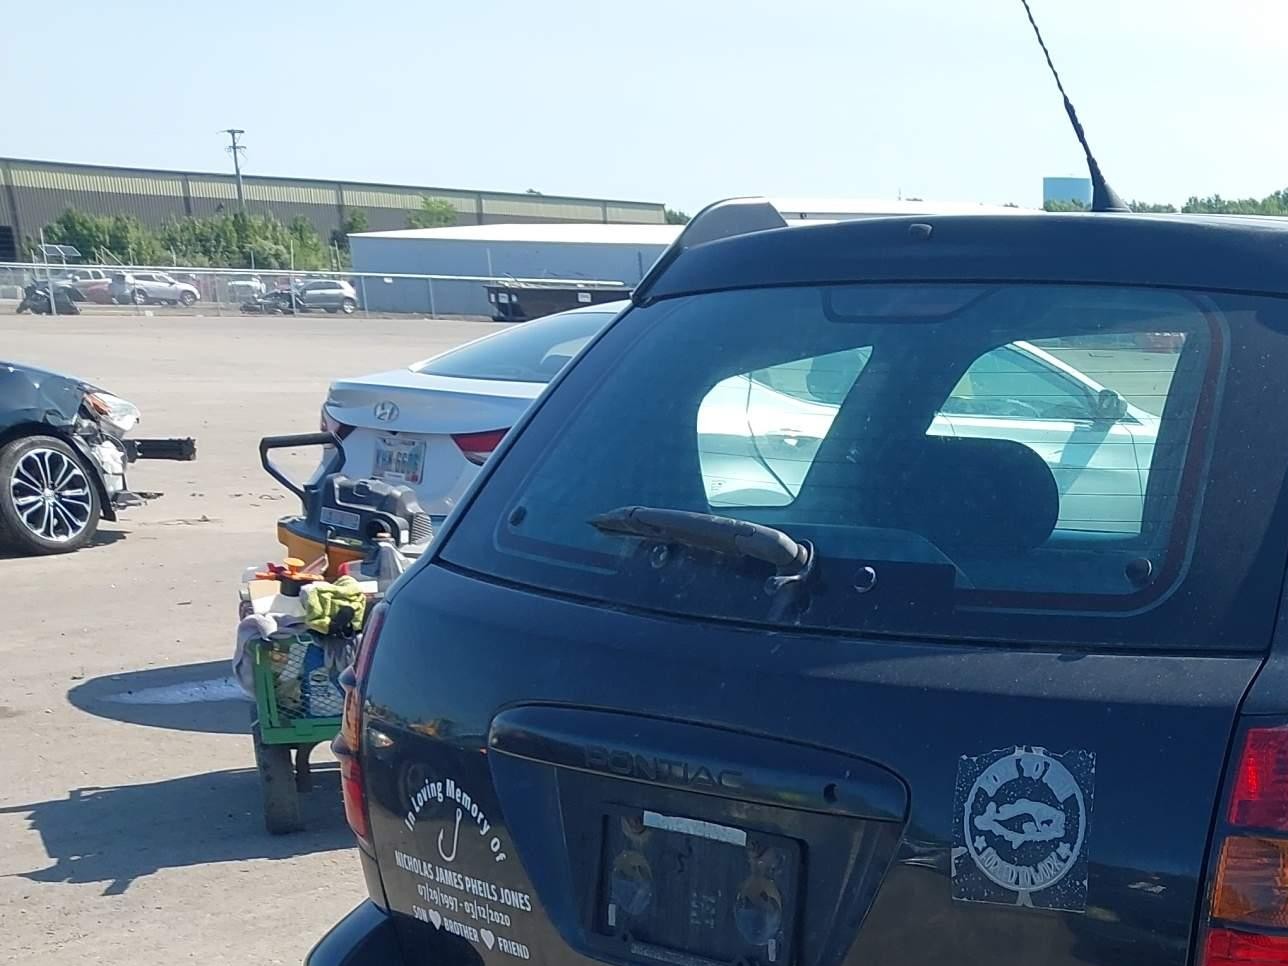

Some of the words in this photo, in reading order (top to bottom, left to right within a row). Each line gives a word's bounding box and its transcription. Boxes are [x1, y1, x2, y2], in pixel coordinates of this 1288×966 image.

[583, 744, 745, 789] PONTIAC
[404, 811, 416, 831] In
[411, 779, 443, 813] Loving
[446, 778, 490, 836] Memory
[394, 850, 434, 880] NICHOLAS
[435, 865, 464, 890] JAMES
[464, 875, 498, 901] PHEILS
[498, 886, 532, 912] JONES
[979, 847, 1016, 884] FORD
[412, 904, 429, 923] SON
[443, 917, 480, 943] BROTHER
[497, 936, 530, 960] FRIEND
[464, 899, 511, 927] 03/12/2020
